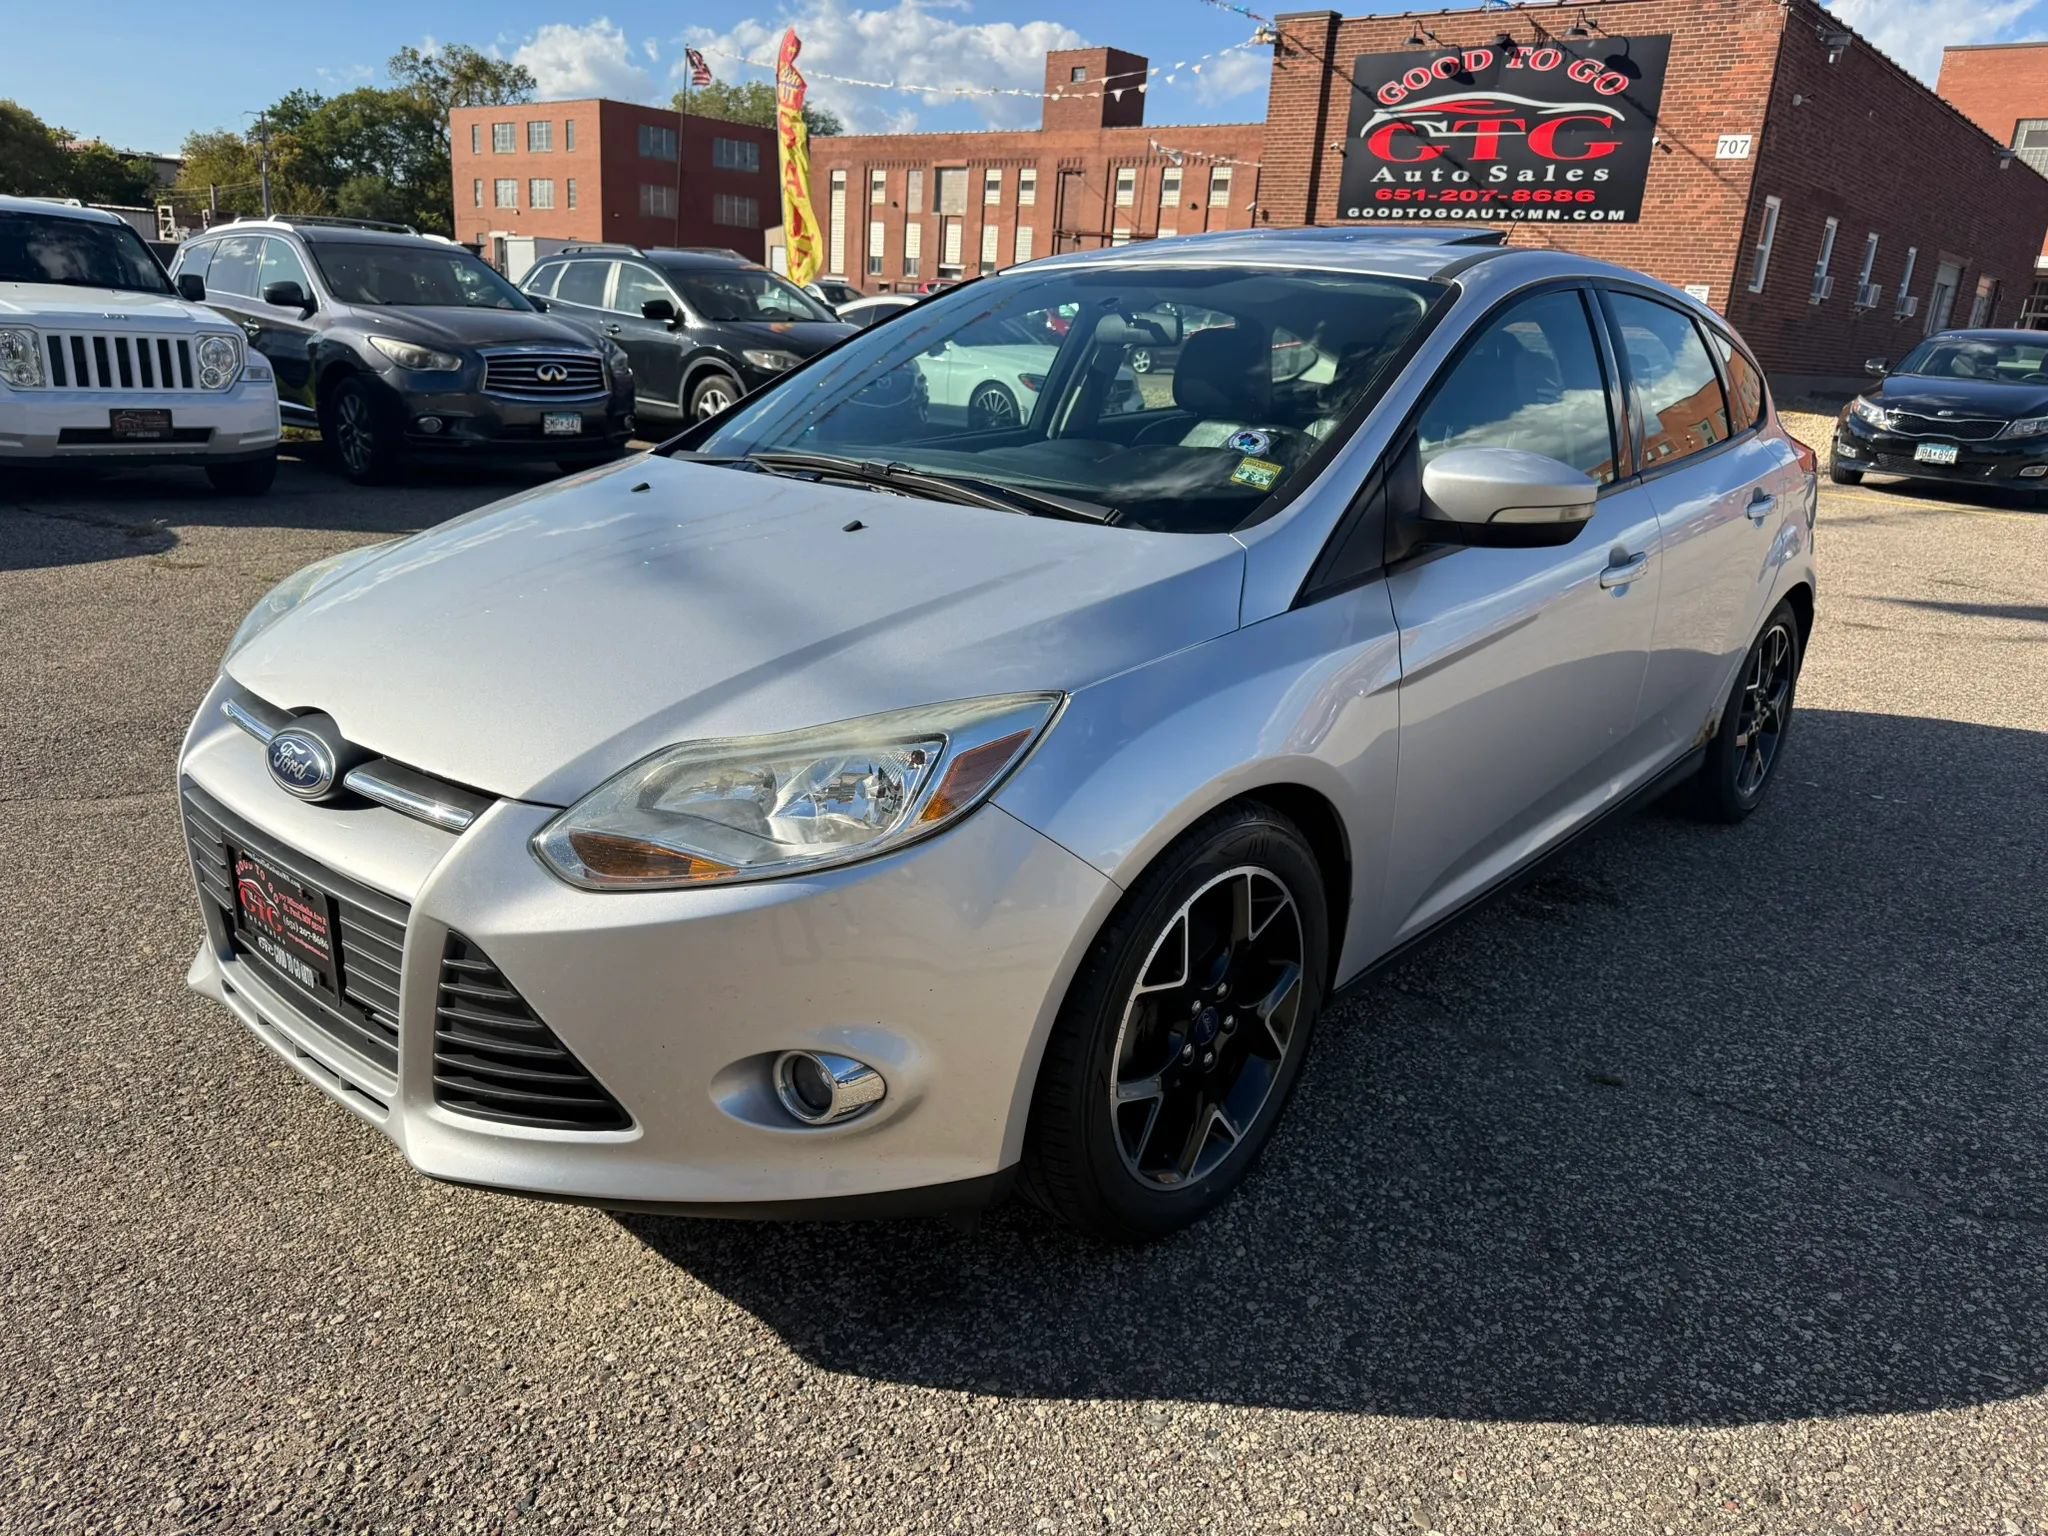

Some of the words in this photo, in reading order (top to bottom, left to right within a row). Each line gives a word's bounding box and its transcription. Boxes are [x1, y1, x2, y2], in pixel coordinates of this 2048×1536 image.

[1377, 49, 1494, 105] GOOD
[1505, 46, 1563, 72] TO
[1567, 58, 1630, 96] GO
[1367, 115, 1623, 162] GTG
[1718, 140, 1749, 155] 707
[1369, 165, 1471, 183] Auto
[1488, 163, 1610, 182] Sales
[1375, 188, 1597, 203] 651-207-8686
[1347, 207, 1626, 221] GOODTOGOAUTOMN.COM
[273, 740, 313, 781] Ford
